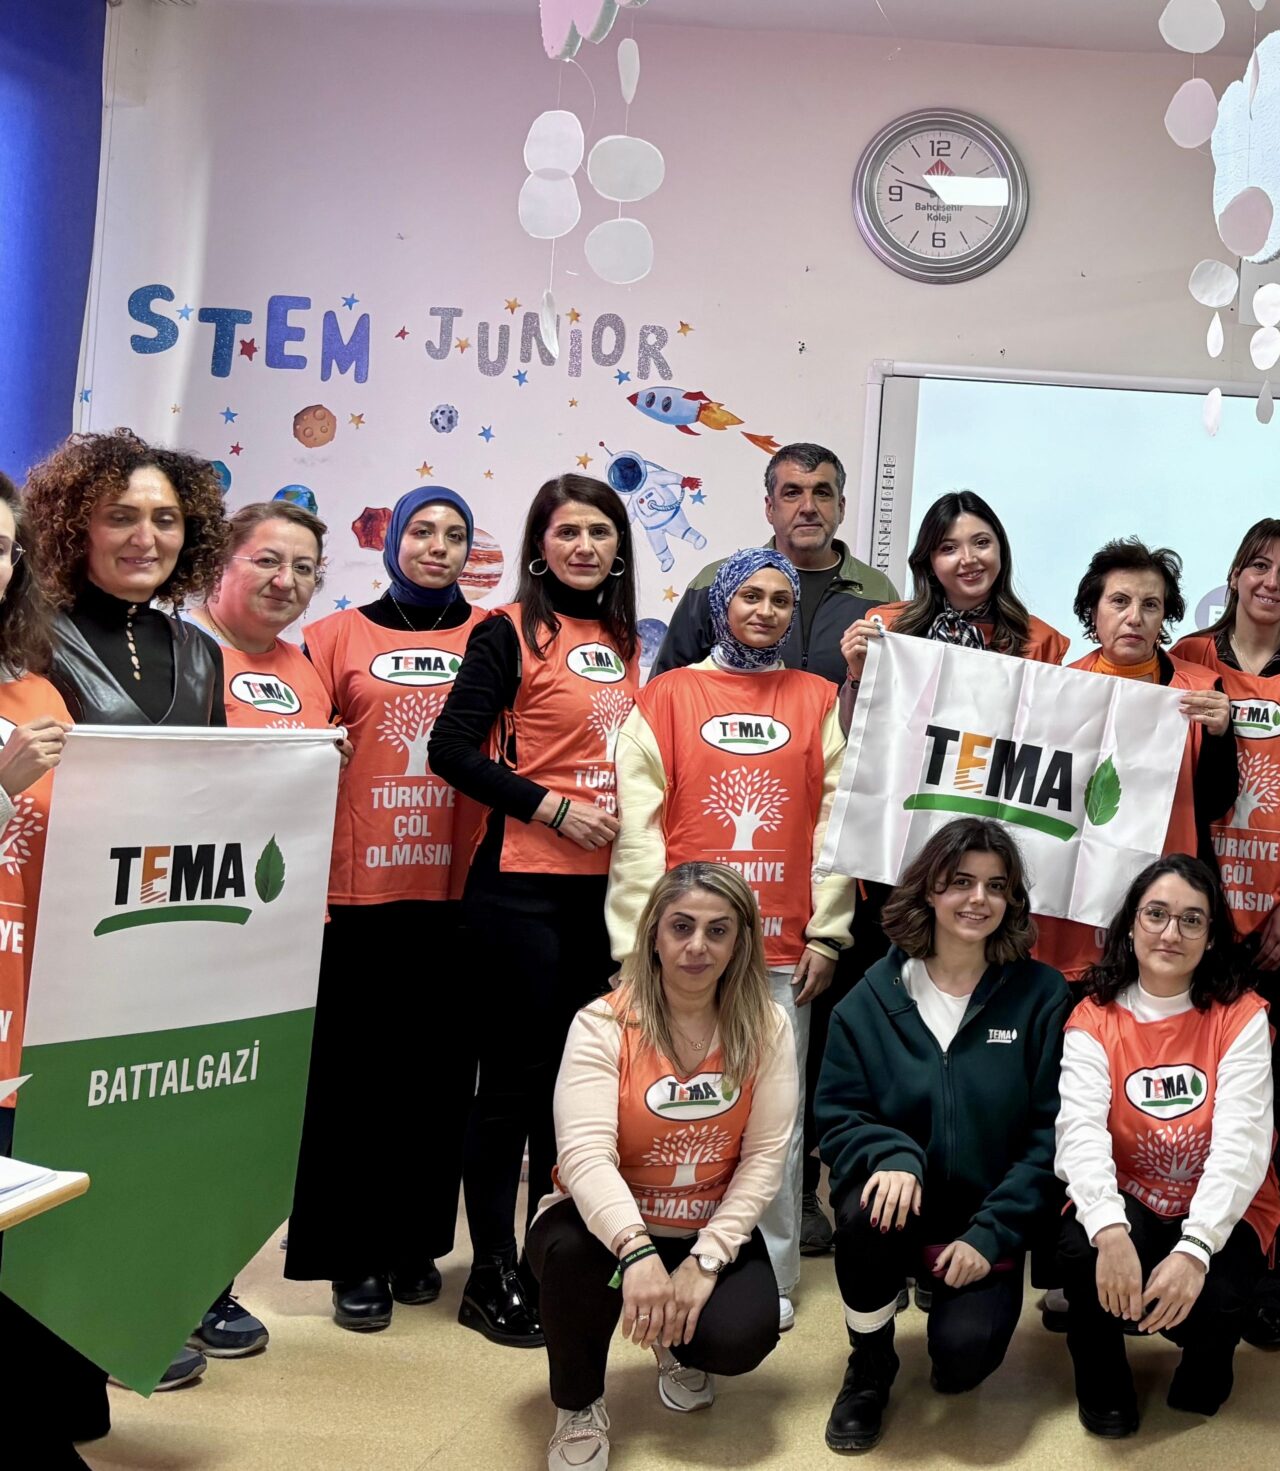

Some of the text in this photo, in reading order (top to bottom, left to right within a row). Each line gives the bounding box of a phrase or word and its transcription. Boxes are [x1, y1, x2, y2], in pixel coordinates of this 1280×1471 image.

[929, 140, 951, 157] 12
[888, 186, 903, 202] 9
[927, 213, 952, 223] Koleji
[932, 232, 946, 248] 6
[127, 284, 369, 383] STEM
[391, 656, 446, 672] TEMA
[580, 651, 613, 668] TEMA
[242, 680, 286, 702] TEMA
[1232, 704, 1270, 723] TEMA
[719, 721, 765, 738] TEMA
[925, 725, 1073, 812] TEMA
[371, 781, 456, 809] TÜRKİYE
[394, 809, 432, 842] ÇÖL
[366, 844, 452, 868] OLMASIN
[1211, 832, 1280, 862] ÜRKİYE
[110, 843, 246, 906] TEMA
[1221, 860, 1254, 887] ÇÖL
[1224, 889, 1274, 912] MASIN
[988, 1029, 1011, 1041] TEMA
[88, 1040, 260, 1107] BATTALGAZİ
[667, 1081, 717, 1102] TEMA
[1143, 1073, 1187, 1099] TEMA
[636, 1197, 721, 1220] LMASIN
